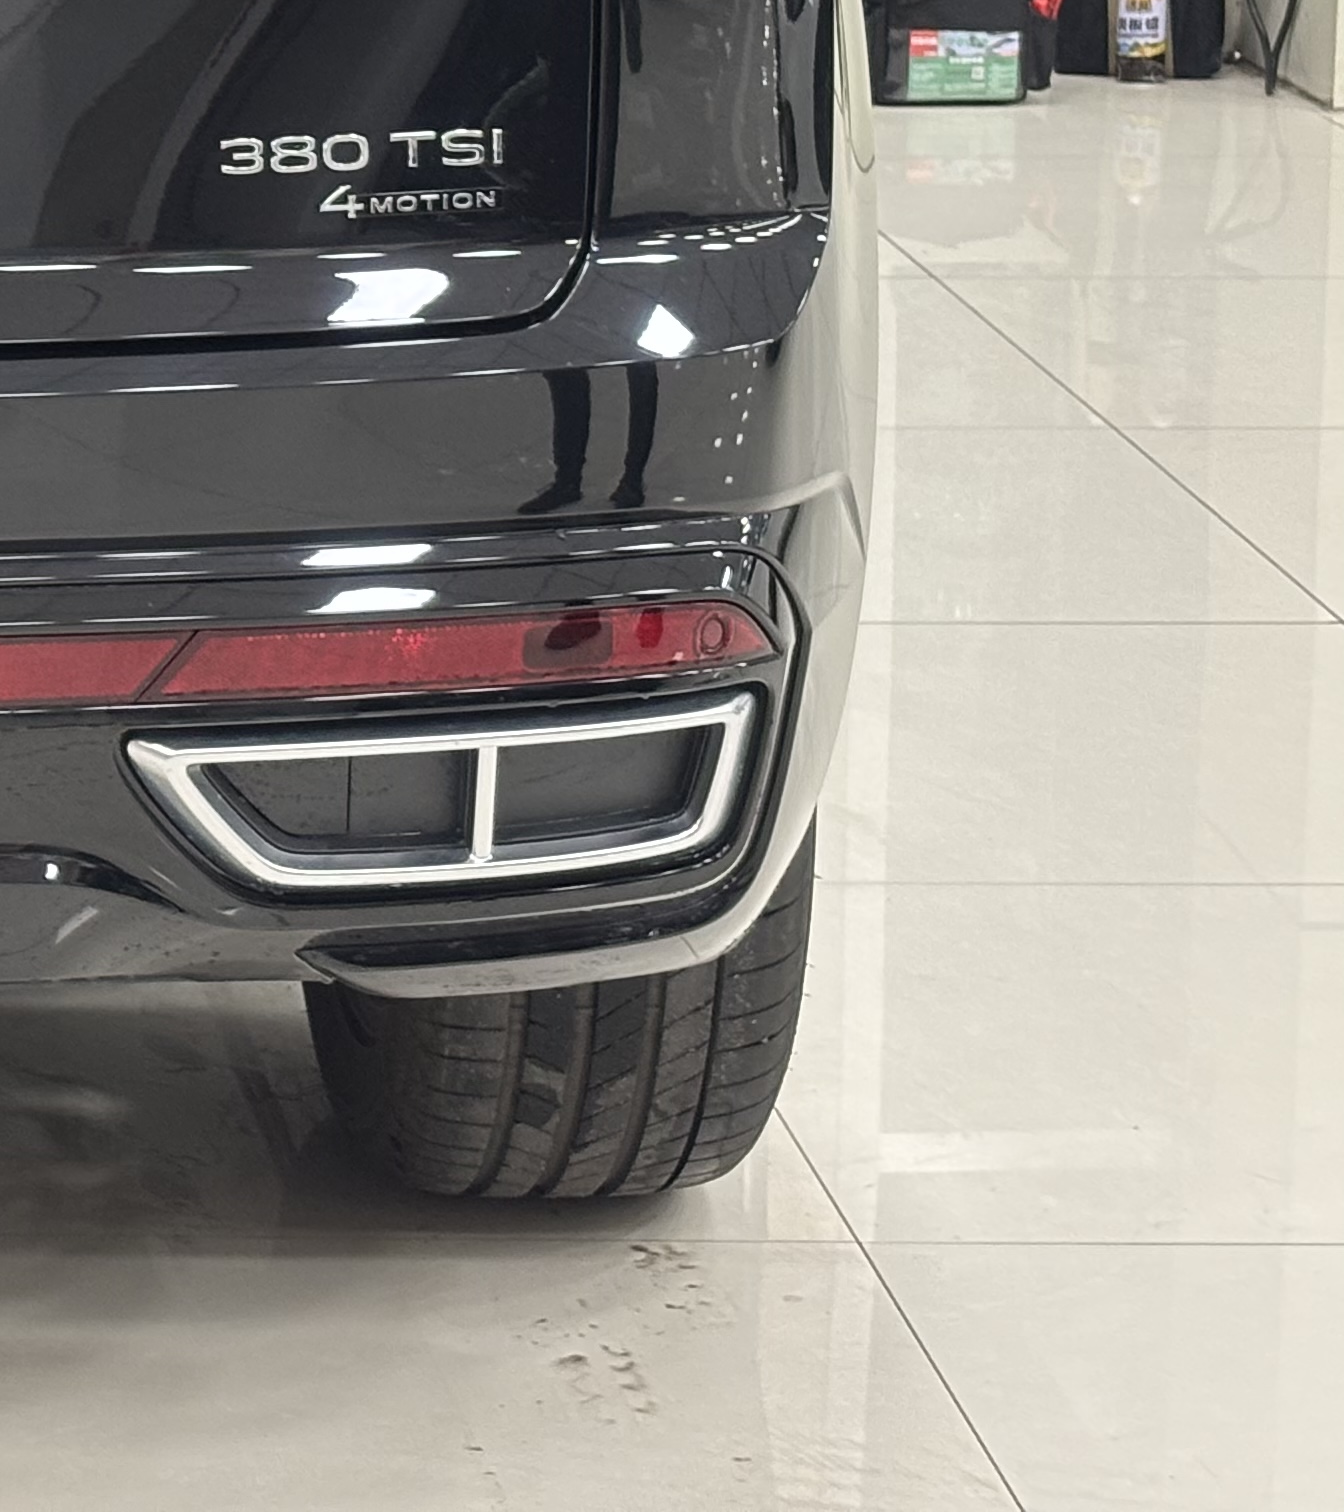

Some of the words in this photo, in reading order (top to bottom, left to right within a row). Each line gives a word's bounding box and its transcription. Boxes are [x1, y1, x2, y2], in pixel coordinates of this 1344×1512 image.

[218, 132, 371, 175] 380
[389, 127, 504, 168] TSI
[318, 183, 497, 220] 4MOTION
